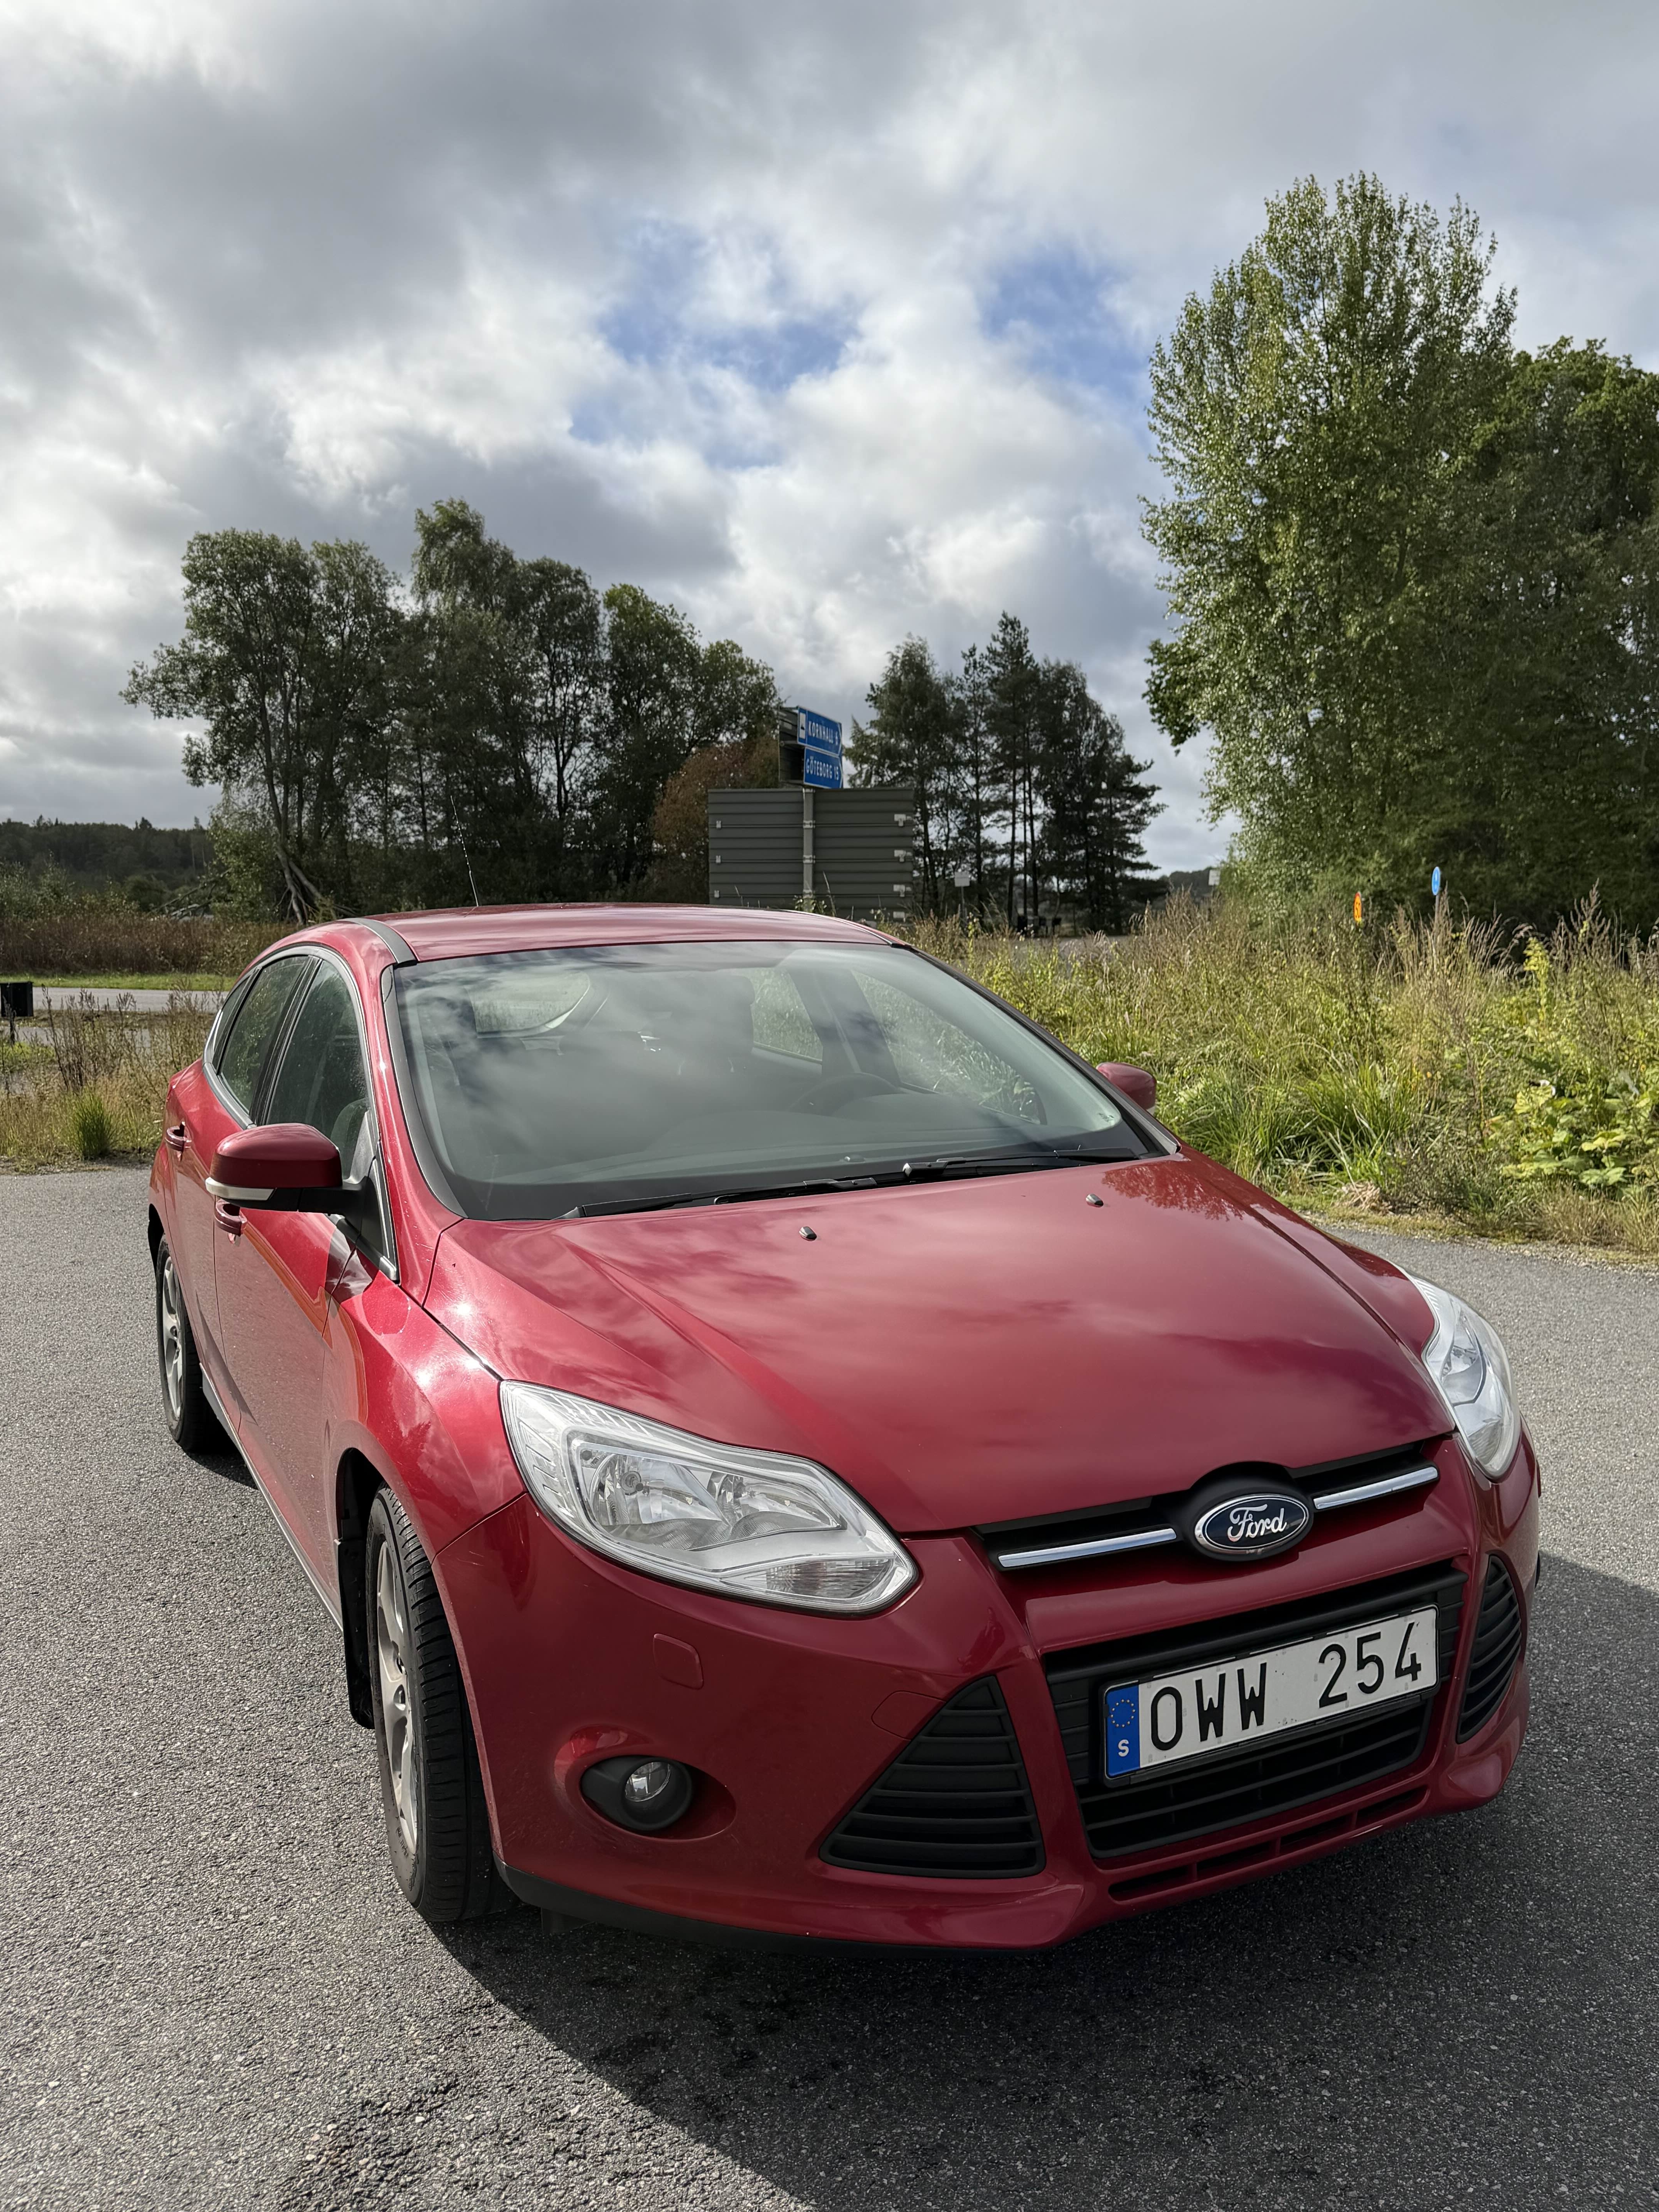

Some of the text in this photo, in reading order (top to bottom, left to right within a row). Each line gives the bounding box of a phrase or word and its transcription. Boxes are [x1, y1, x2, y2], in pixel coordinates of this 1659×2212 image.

[808, 721, 833, 744] KORNHALL
[806, 756, 839, 781] GÖTEBORG 15
[1227, 1504, 1287, 1542] Ford
[1151, 1622, 1422, 1751] OWW 254
[1118, 1739, 1129, 1757] S
